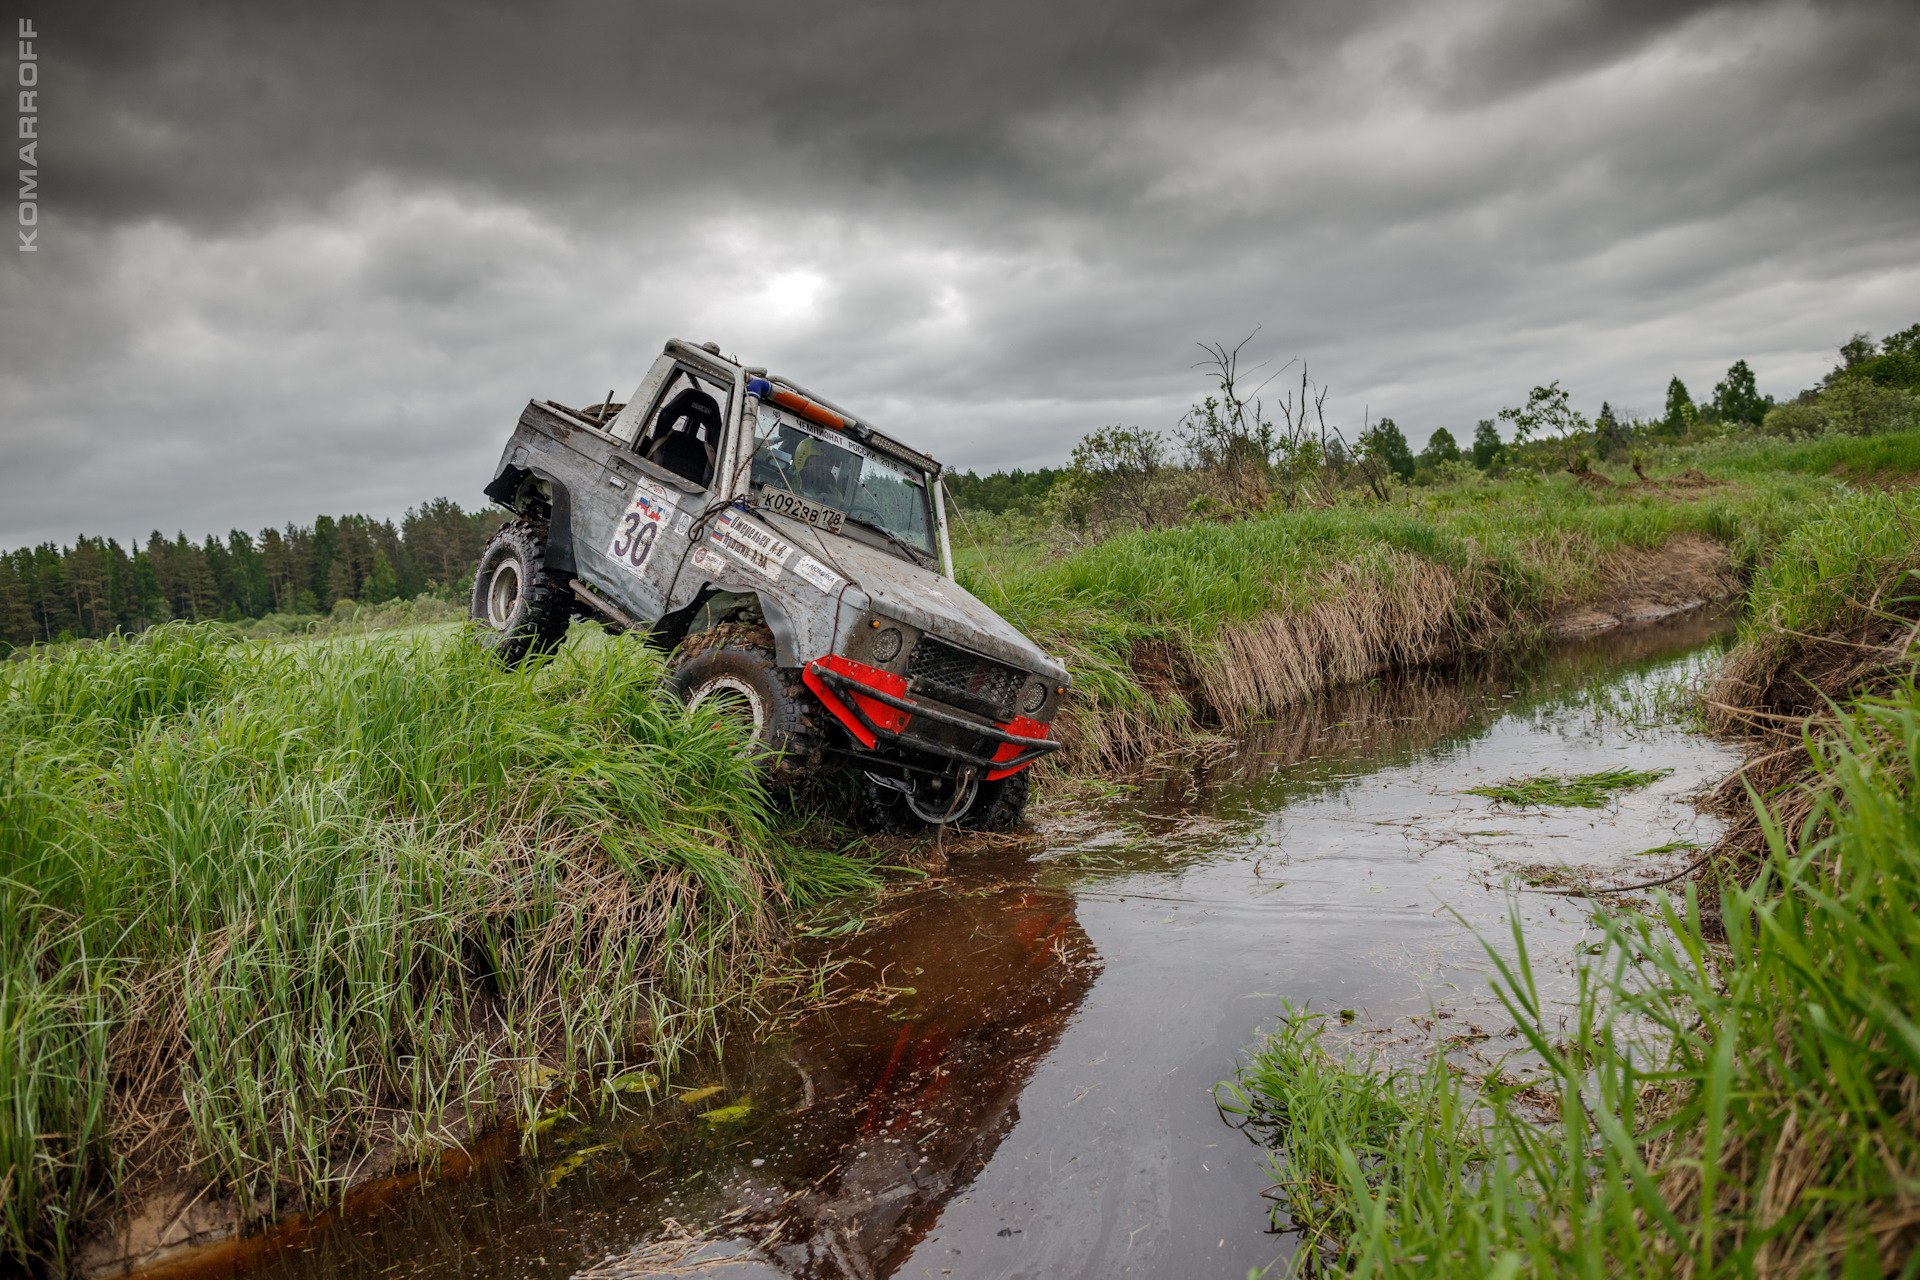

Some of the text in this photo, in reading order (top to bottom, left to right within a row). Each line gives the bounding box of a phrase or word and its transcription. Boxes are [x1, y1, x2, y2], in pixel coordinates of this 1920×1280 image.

[796, 419, 898, 472] ЧЕМПИОНАТ РОССИИ 2018
[614, 512, 658, 567] 30
[730, 515, 788, 559] Ожерельев А.В.
[822, 509, 842, 526] 178
